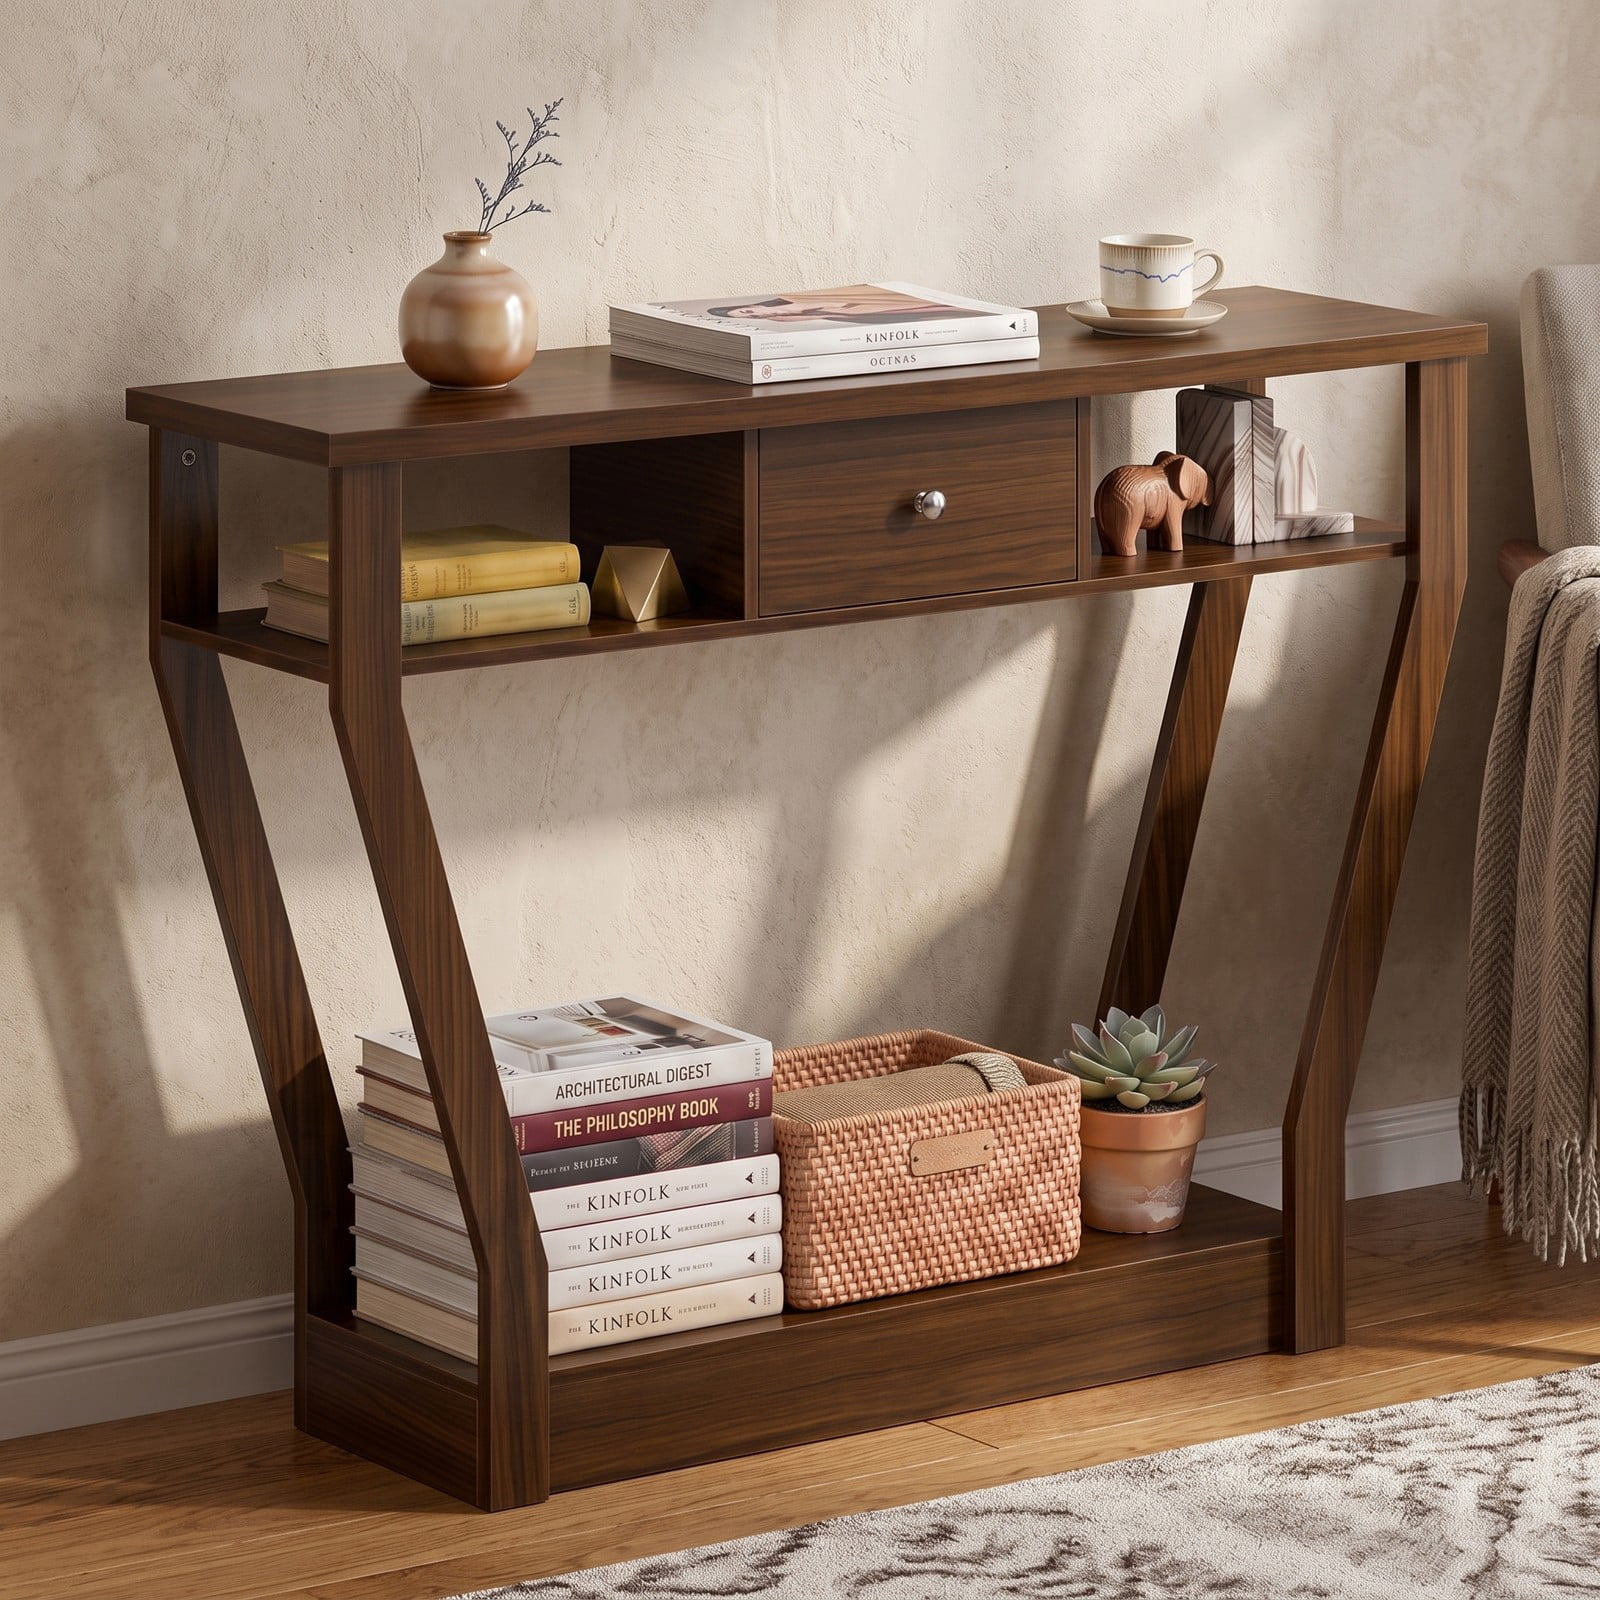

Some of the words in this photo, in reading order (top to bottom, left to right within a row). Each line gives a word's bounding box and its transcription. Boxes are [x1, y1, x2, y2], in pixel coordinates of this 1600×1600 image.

[866, 329, 920, 343] KINFOLK
[870, 354, 917, 367] OCTNAS
[555, 1071, 662, 1100] ARCHITECTURAL
[666, 1063, 712, 1083] DIGEST
[554, 1118, 582, 1139] THE
[586, 1104, 676, 1134] PHILOSOPHY
[680, 1097, 719, 1119] BOOK
[587, 1184, 670, 1212] KINFOLK
[589, 1224, 672, 1252] KINFOLK
[589, 1264, 672, 1293] KINFOLK
[589, 1306, 673, 1335] KINFOLK
